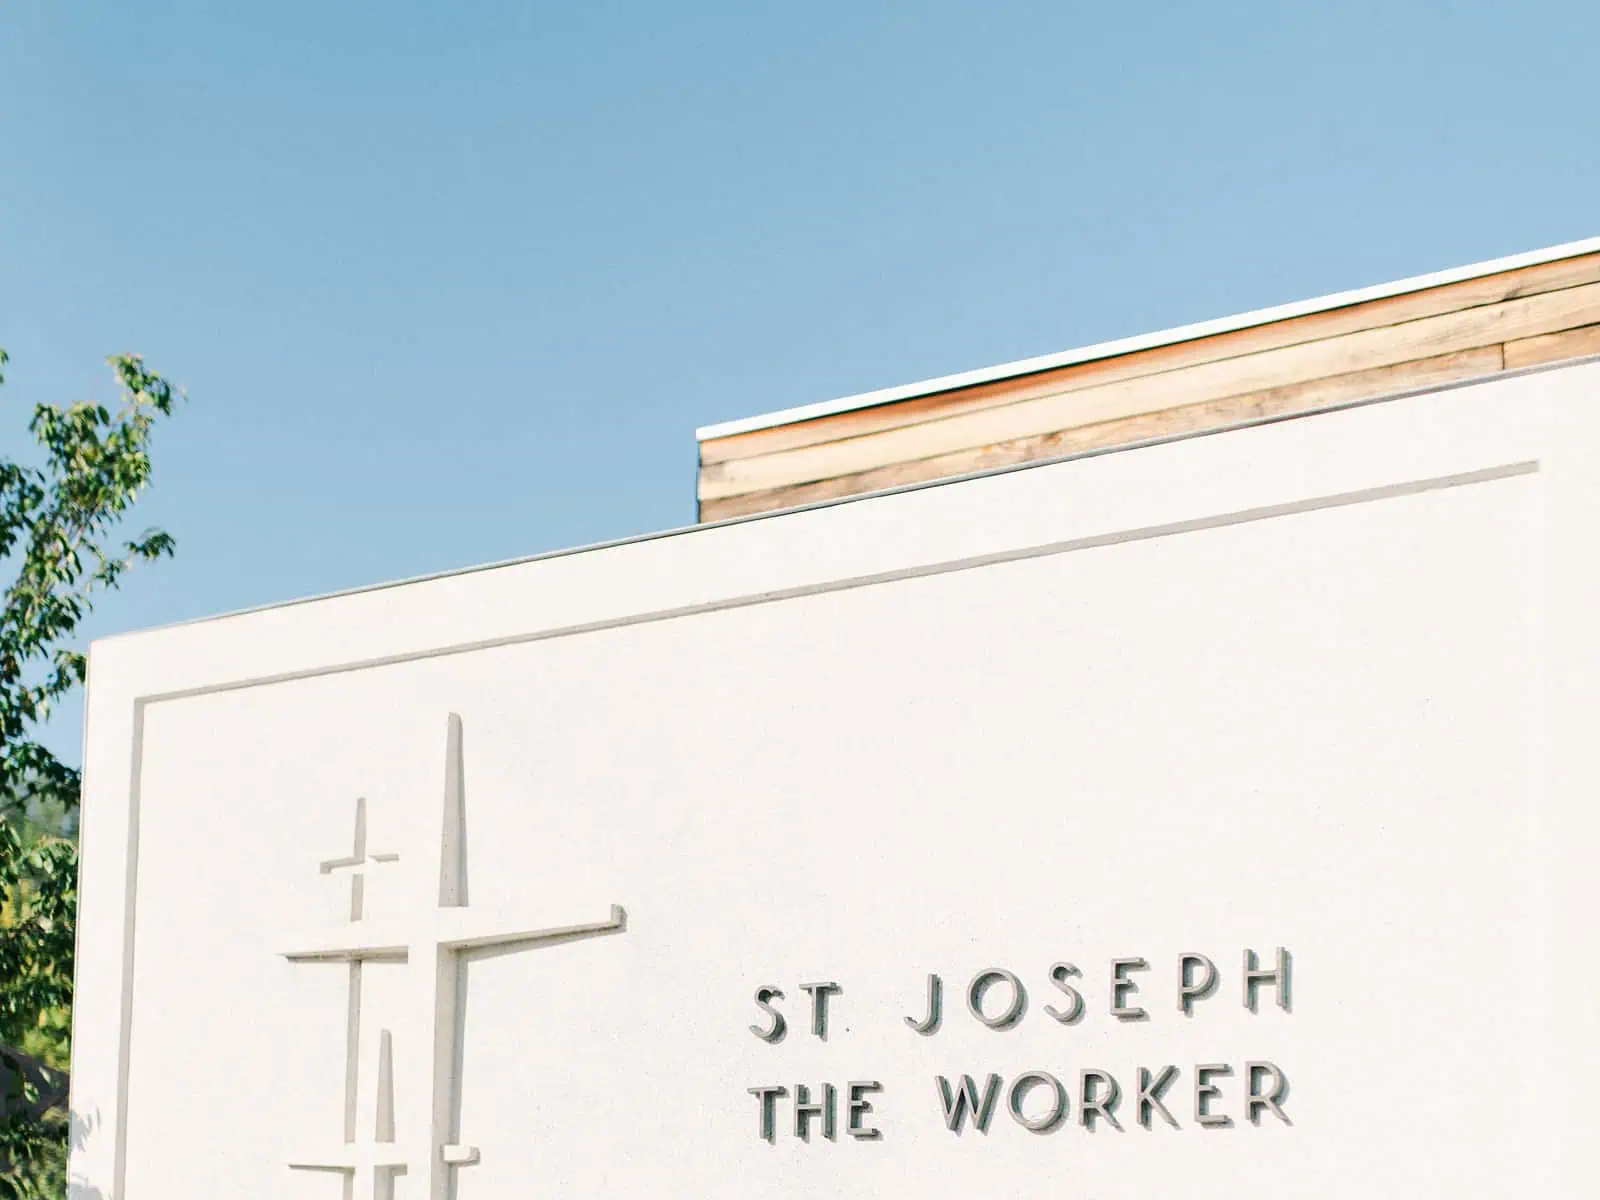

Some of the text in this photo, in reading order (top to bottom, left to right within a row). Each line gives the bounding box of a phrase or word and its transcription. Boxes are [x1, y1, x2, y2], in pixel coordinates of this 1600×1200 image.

[749, 947, 1291, 1042] ST JOSEPH
[747, 1061, 1292, 1142] THE WORKER
